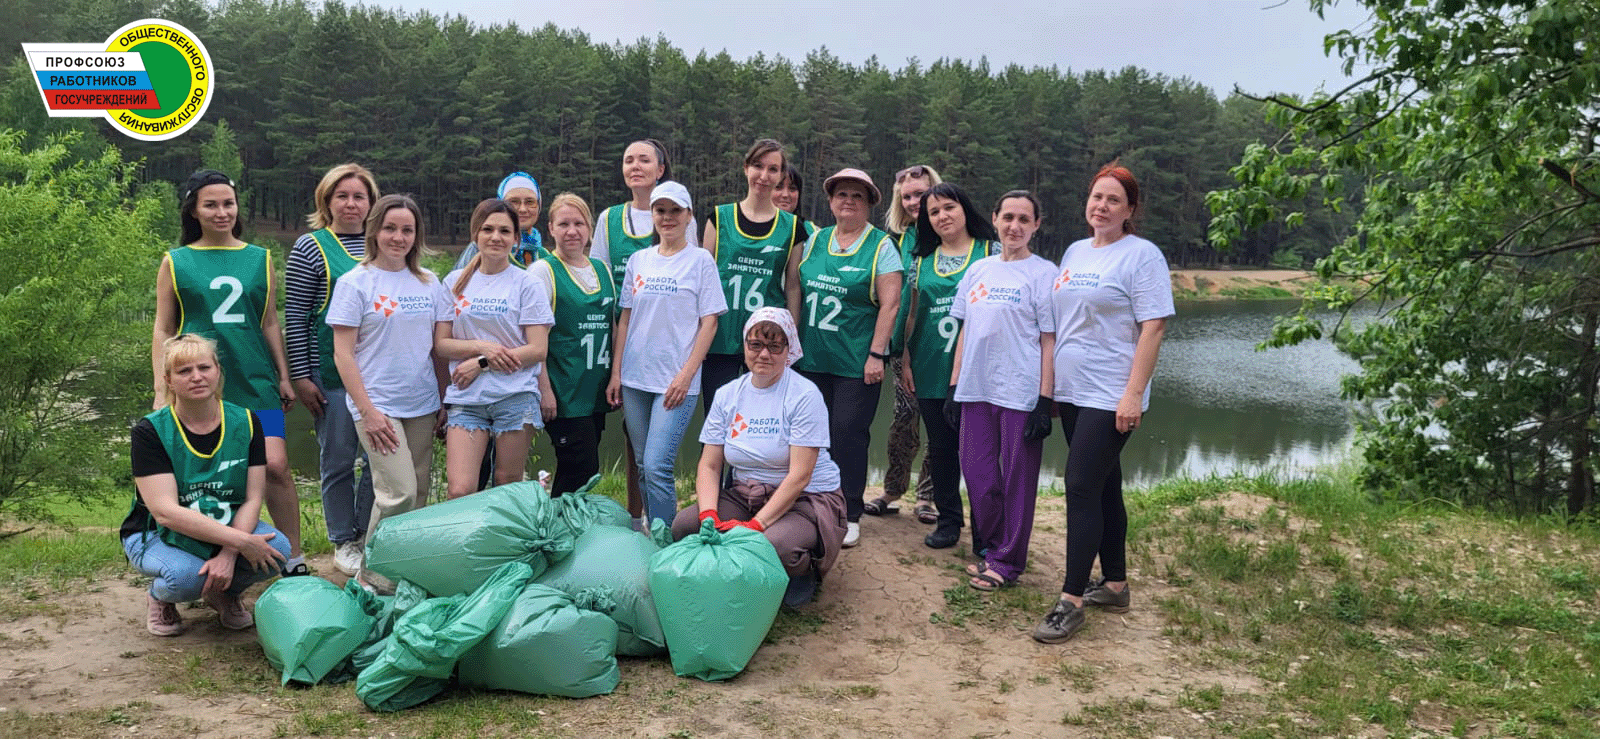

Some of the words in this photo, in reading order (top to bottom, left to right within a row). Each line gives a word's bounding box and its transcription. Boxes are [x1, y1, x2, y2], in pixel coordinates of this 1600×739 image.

[737, 256, 764, 266] ЦЕНТР
[727, 263, 773, 276] ЗАНЯТОСТИ
[646, 276, 678, 286] РАБОТА
[817, 274, 841, 284] ЦЕНТР
[644, 283, 678, 293] РОССИИ
[806, 280, 848, 294] ЗАНЯТОСТИ
[990, 287, 1021, 296] РАБОТА
[728, 274, 764, 312] 16
[209, 275, 246, 324] 2
[472, 297, 509, 305] РАБОТА
[470, 304, 509, 314] РОССИИ
[805, 291, 843, 332] 12
[938, 316, 959, 353] 9
[580, 333, 611, 370] 14
[749, 418, 780, 426] РАБОТА
[189, 481, 223, 491] ЦЕНТР
